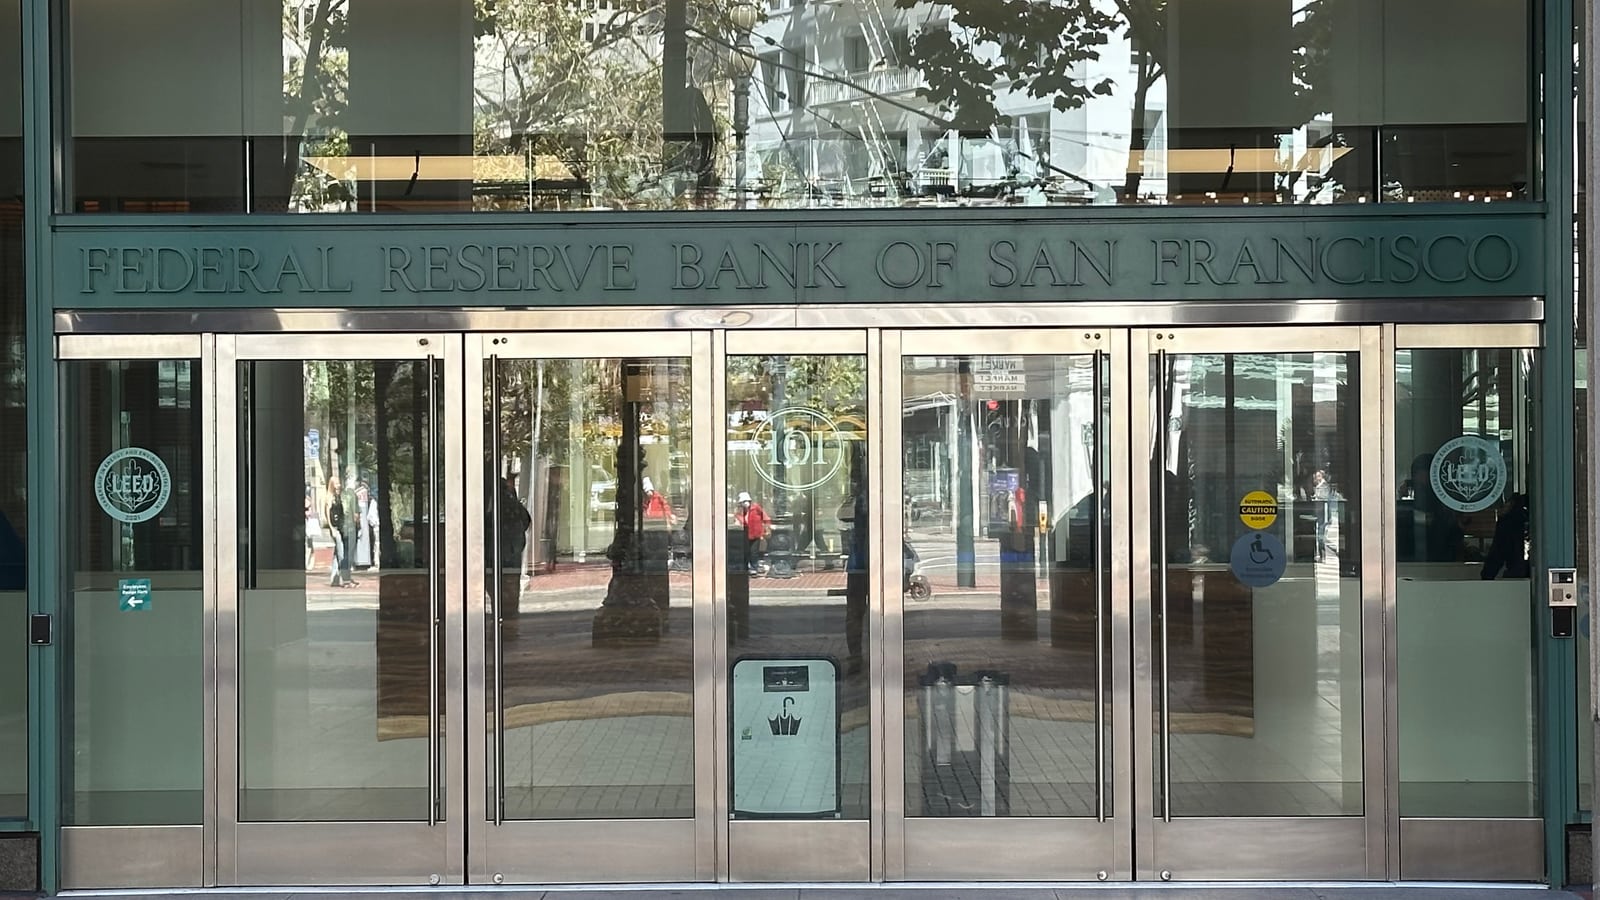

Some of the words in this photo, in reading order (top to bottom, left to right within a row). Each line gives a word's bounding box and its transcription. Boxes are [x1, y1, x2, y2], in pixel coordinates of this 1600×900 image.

[79, 246, 353, 294] FEDERAL
[380, 244, 637, 293] RESERVE
[672, 241, 846, 289] BANK
[875, 240, 957, 289] OF
[988, 239, 1118, 287] SAN
[1151, 234, 1519, 285] FRANCISCO
[767, 430, 829, 465] 101
[112, 474, 154, 493] LEED
